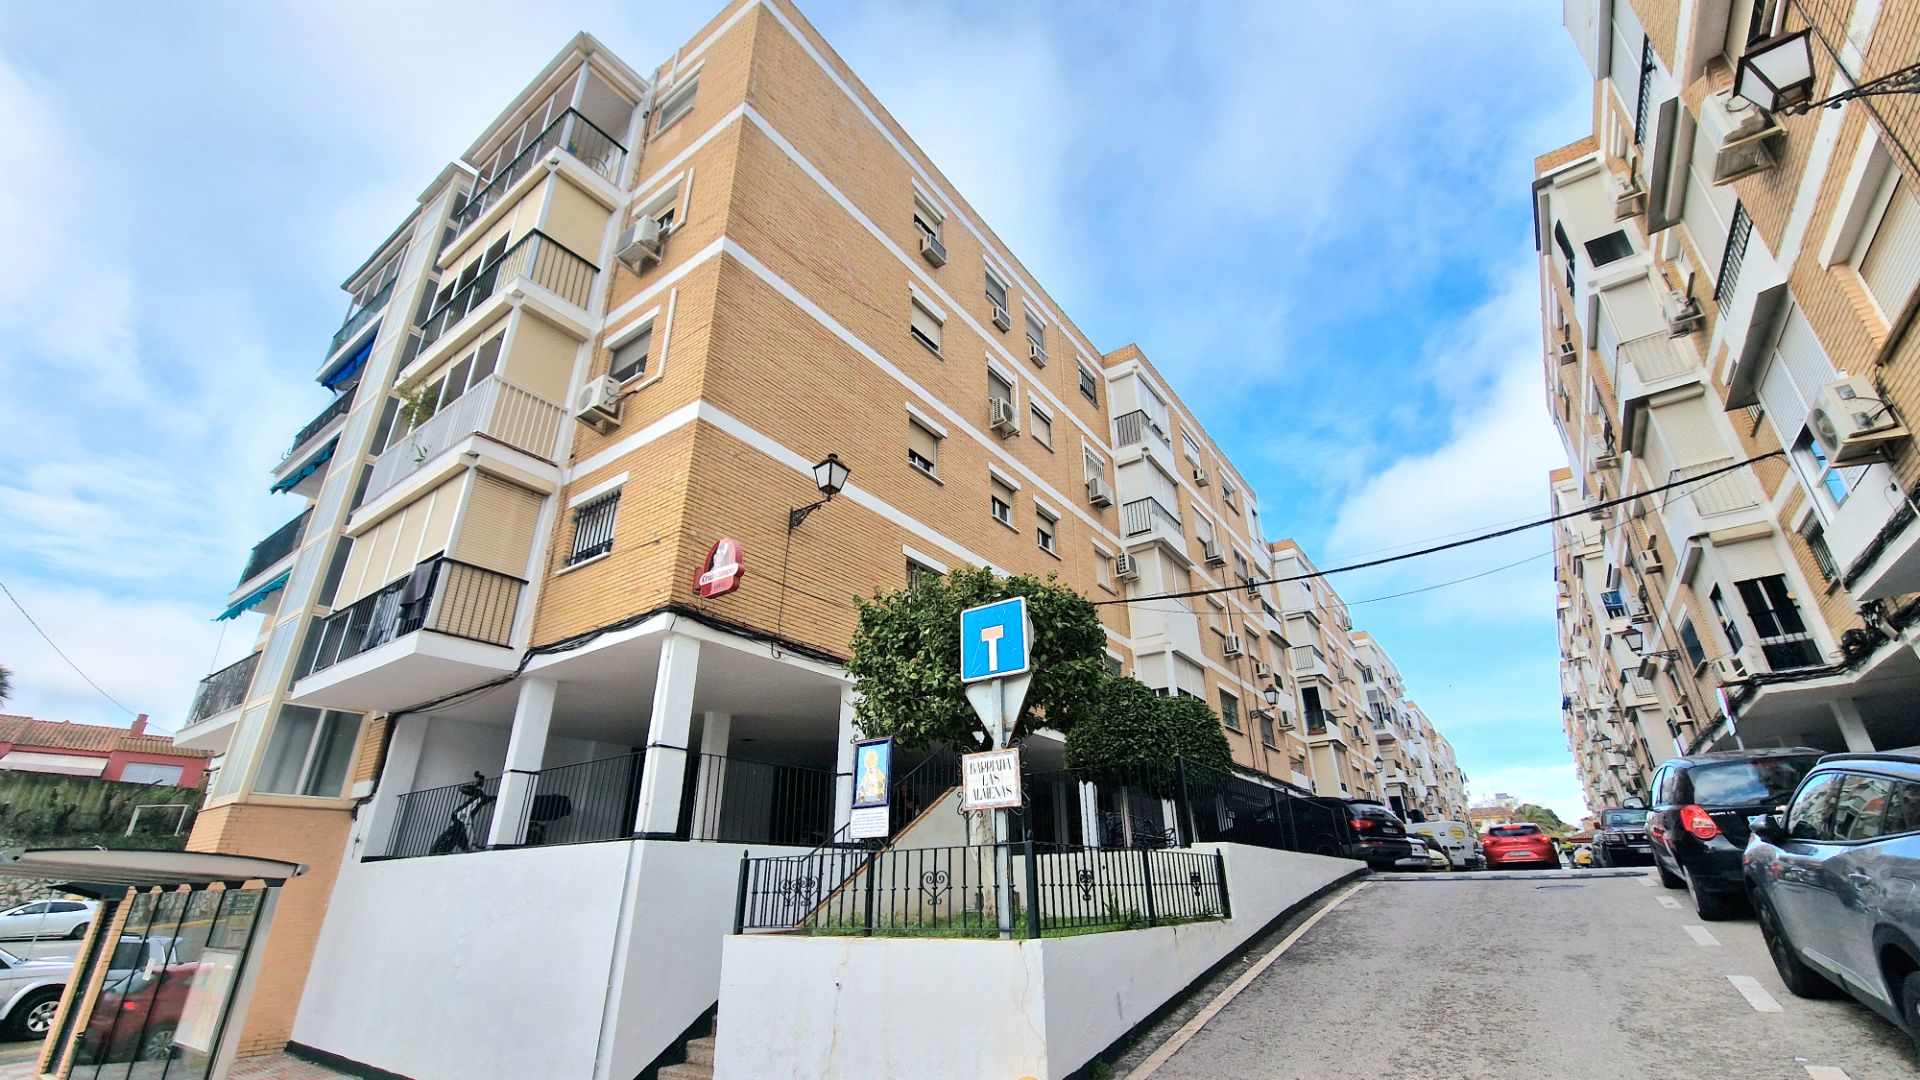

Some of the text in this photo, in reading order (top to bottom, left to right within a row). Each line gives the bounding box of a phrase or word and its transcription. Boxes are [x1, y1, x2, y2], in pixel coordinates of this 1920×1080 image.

[969, 757, 1012, 775] BARRIADA
[982, 773, 1000, 787] LAS
[972, 785, 1013, 801] ALMENAS
